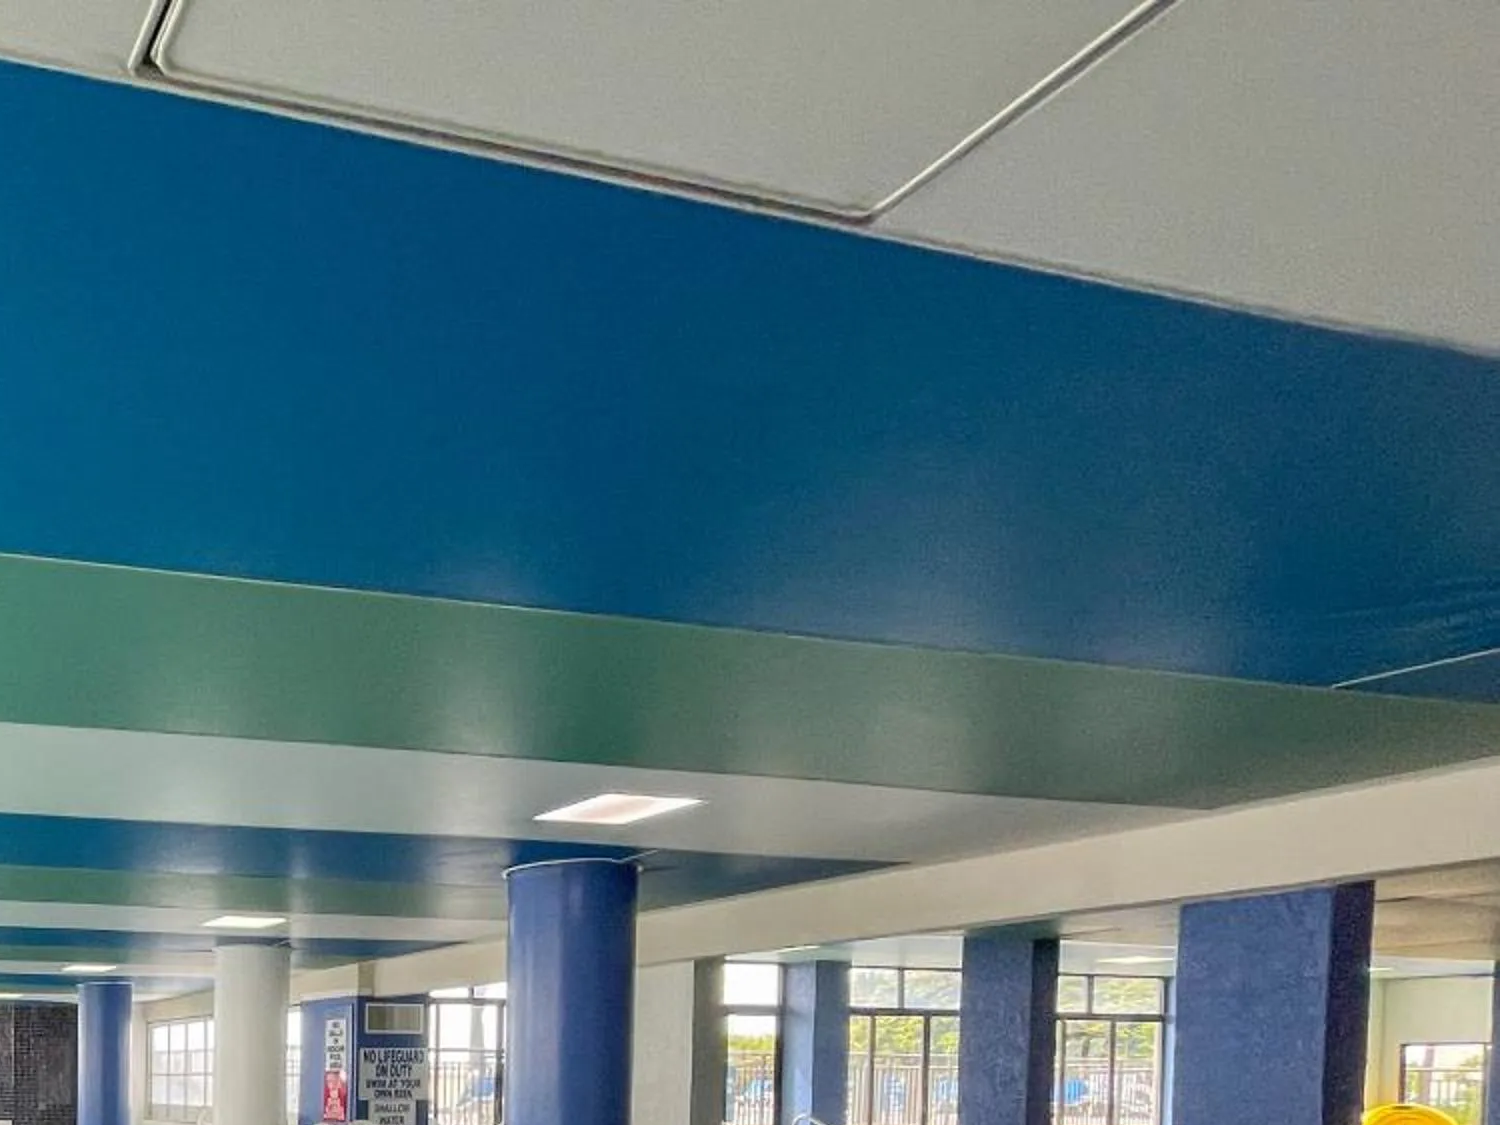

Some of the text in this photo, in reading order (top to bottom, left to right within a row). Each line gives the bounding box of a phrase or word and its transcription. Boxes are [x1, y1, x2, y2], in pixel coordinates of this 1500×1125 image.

[364, 1050, 424, 1063] NO LIFEGUARD
[375, 1064, 412, 1077] ON DUTY
